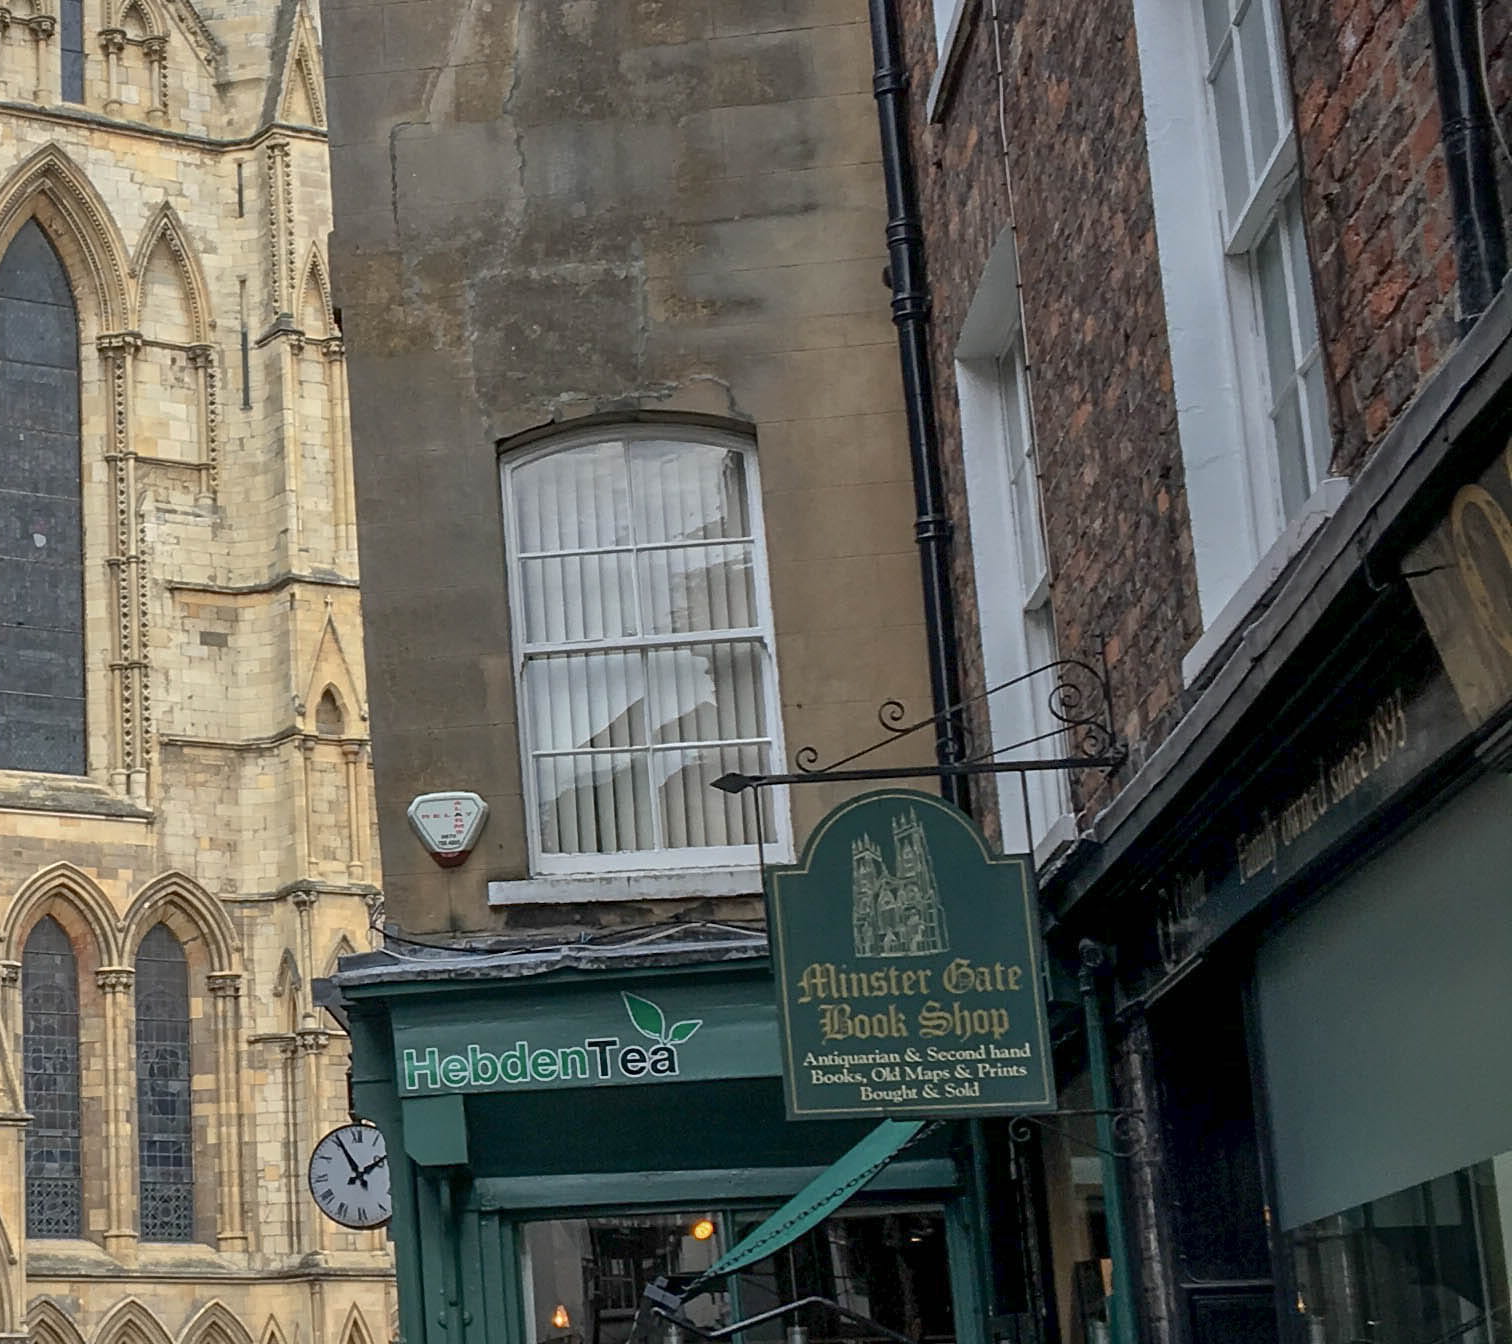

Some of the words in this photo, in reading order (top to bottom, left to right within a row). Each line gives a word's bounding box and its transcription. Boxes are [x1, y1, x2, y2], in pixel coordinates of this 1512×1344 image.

[797, 961, 932, 1004] Minster
[942, 957, 1023, 994] Gate
[818, 1002, 909, 1046] Book
[918, 1000, 1010, 1043] Shop
[402, 1037, 681, 1090] HebdenTea
[803, 1048, 900, 1069] Antiquarian
[904, 1047, 922, 1062] &
[927, 1045, 986, 1061] Second
[989, 1042, 1032, 1059] hand
[811, 1069, 867, 1086] Books,
[871, 1066, 901, 1083] Old
[904, 1066, 951, 1086] Maps
[955, 1065, 972, 1079] &
[977, 1062, 1028, 1079] Prints
[860, 1084, 918, 1103] Bought
[921, 1084, 940, 1099] &
[945, 1081, 980, 1098] Sold
